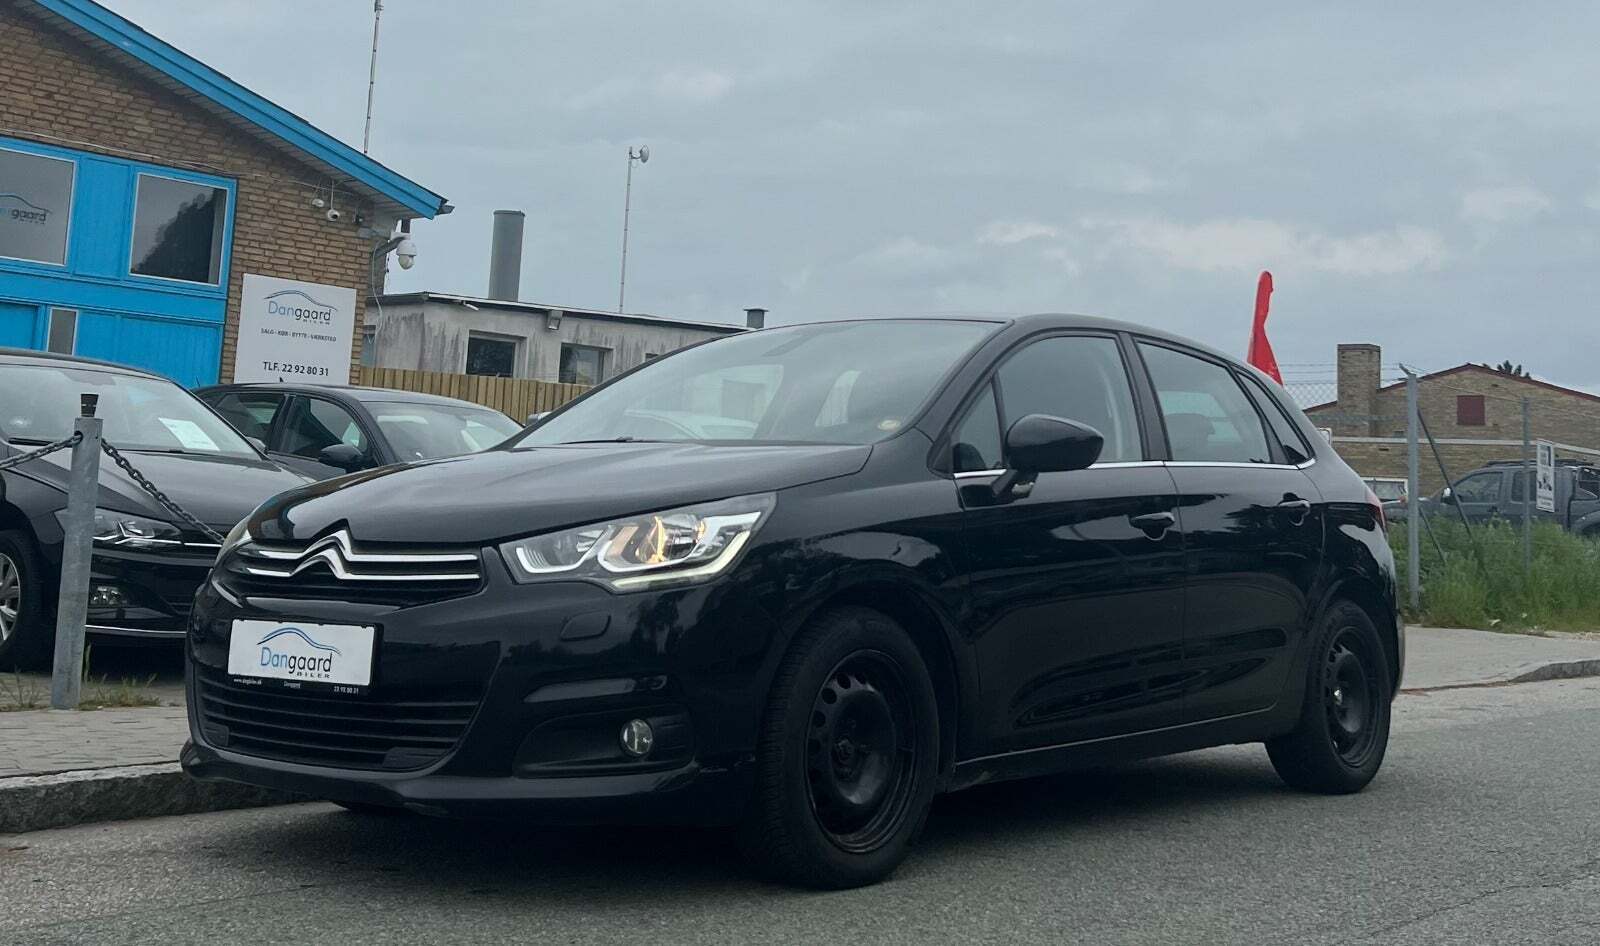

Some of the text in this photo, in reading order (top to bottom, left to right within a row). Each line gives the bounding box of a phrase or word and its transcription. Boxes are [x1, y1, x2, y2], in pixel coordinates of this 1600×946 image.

[268, 300, 331, 321] Dangaard
[263, 361, 329, 376] TLF. 22 92 80 31
[260, 646, 333, 674] Dangaard
[296, 671, 331, 679] BILER
